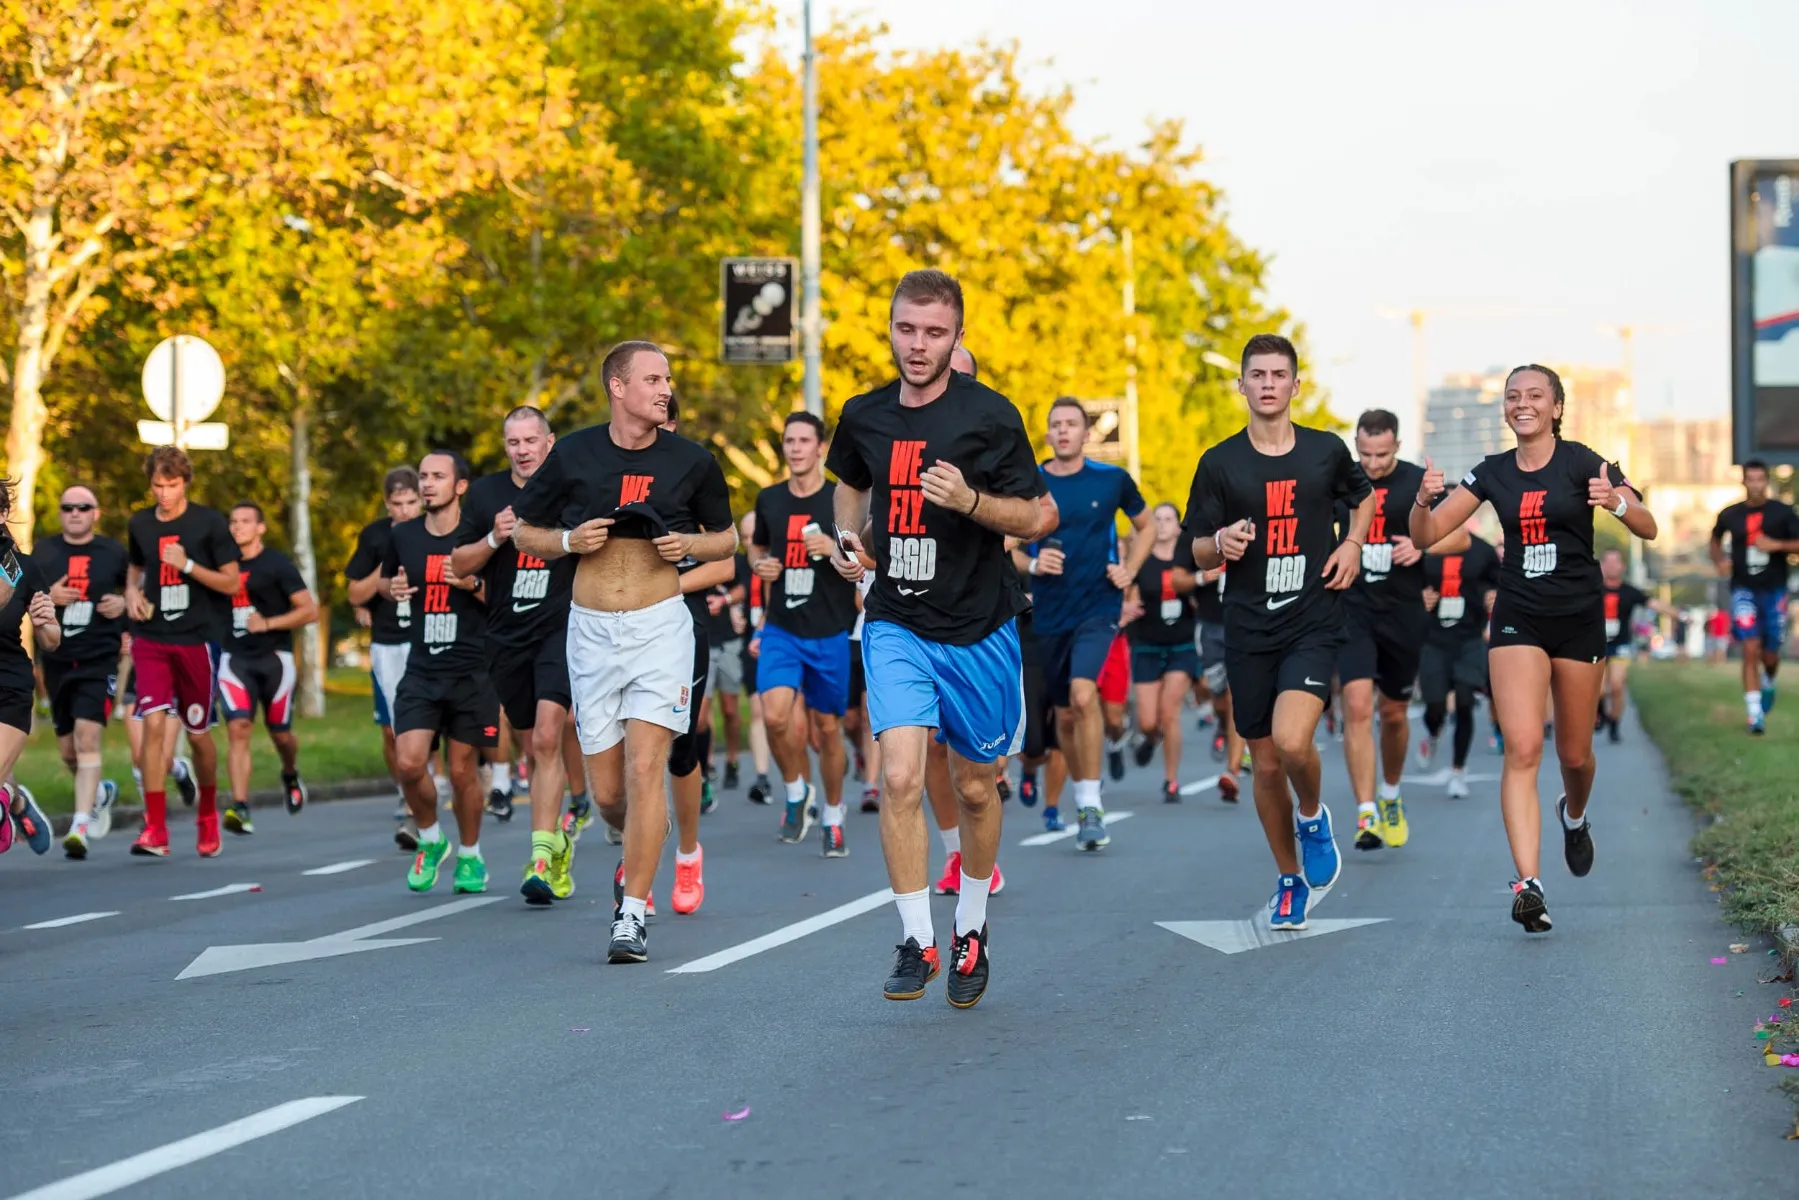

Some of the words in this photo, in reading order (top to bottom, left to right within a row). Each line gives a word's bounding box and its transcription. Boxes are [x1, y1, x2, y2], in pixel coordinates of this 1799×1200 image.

[889, 440, 927, 485] WE
[1266, 480, 1297, 517] WE
[1375, 488, 1388, 515] E
[1519, 490, 1547, 518] WE
[1266, 517, 1300, 555] FLY.
[888, 537, 936, 581] BGD
[1265, 555, 1306, 593] BGD
[1522, 543, 1557, 572] BGD
[512, 570, 550, 599] BGD
[424, 613, 457, 643] BGD
